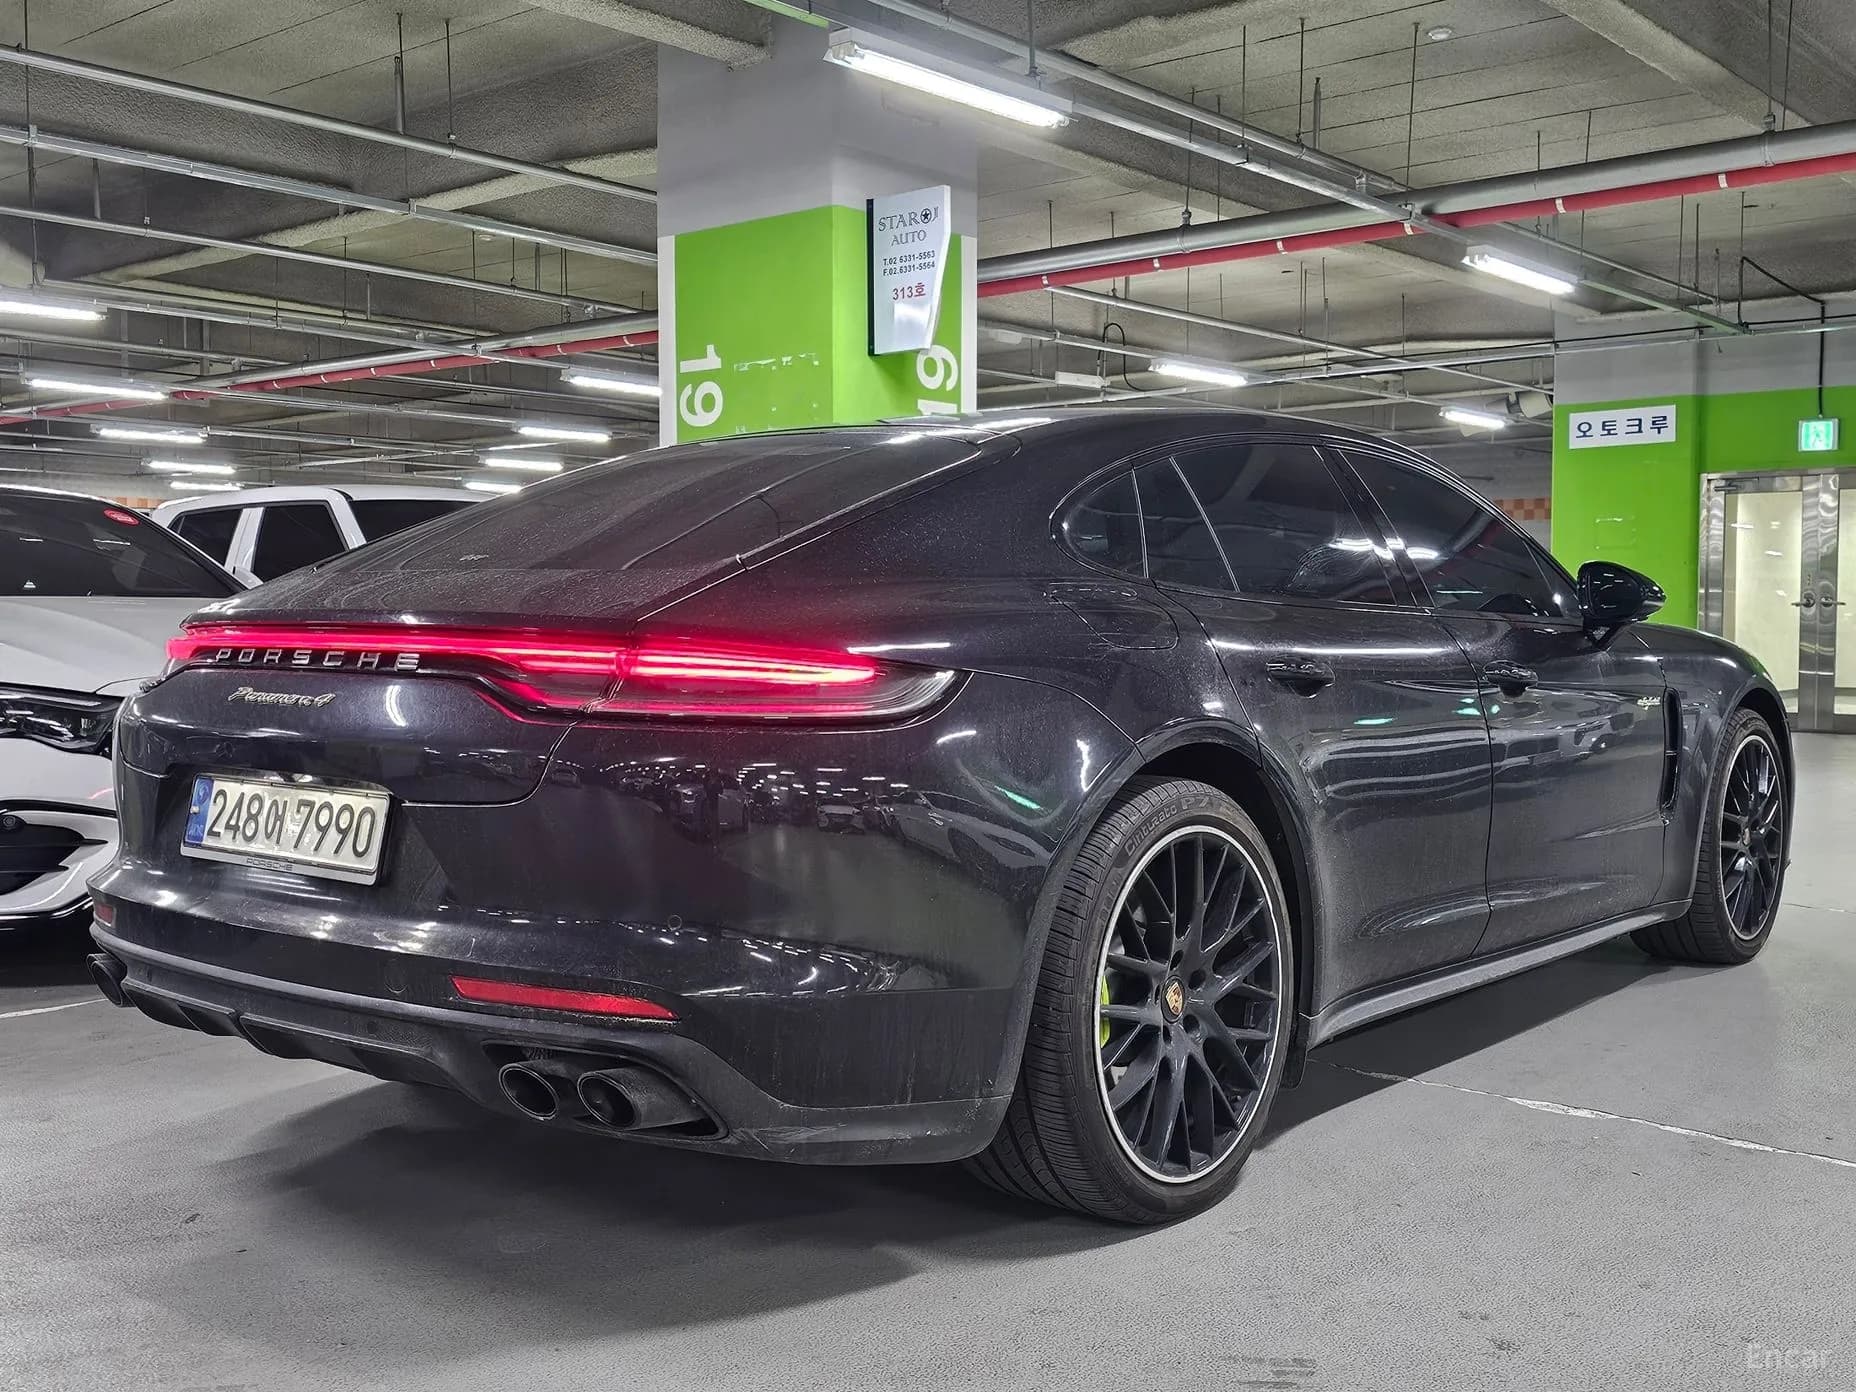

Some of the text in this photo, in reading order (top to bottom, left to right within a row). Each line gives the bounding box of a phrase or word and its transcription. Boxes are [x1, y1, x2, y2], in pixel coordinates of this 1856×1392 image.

[891, 229, 927, 246] AUTO
[892, 282, 926, 300] 313호
[679, 344, 724, 427] 19
[1575, 415, 1669, 439] 오토크루
[215, 649, 420, 671] PORSCHE
[246, 857, 293, 871] PORSCHE
